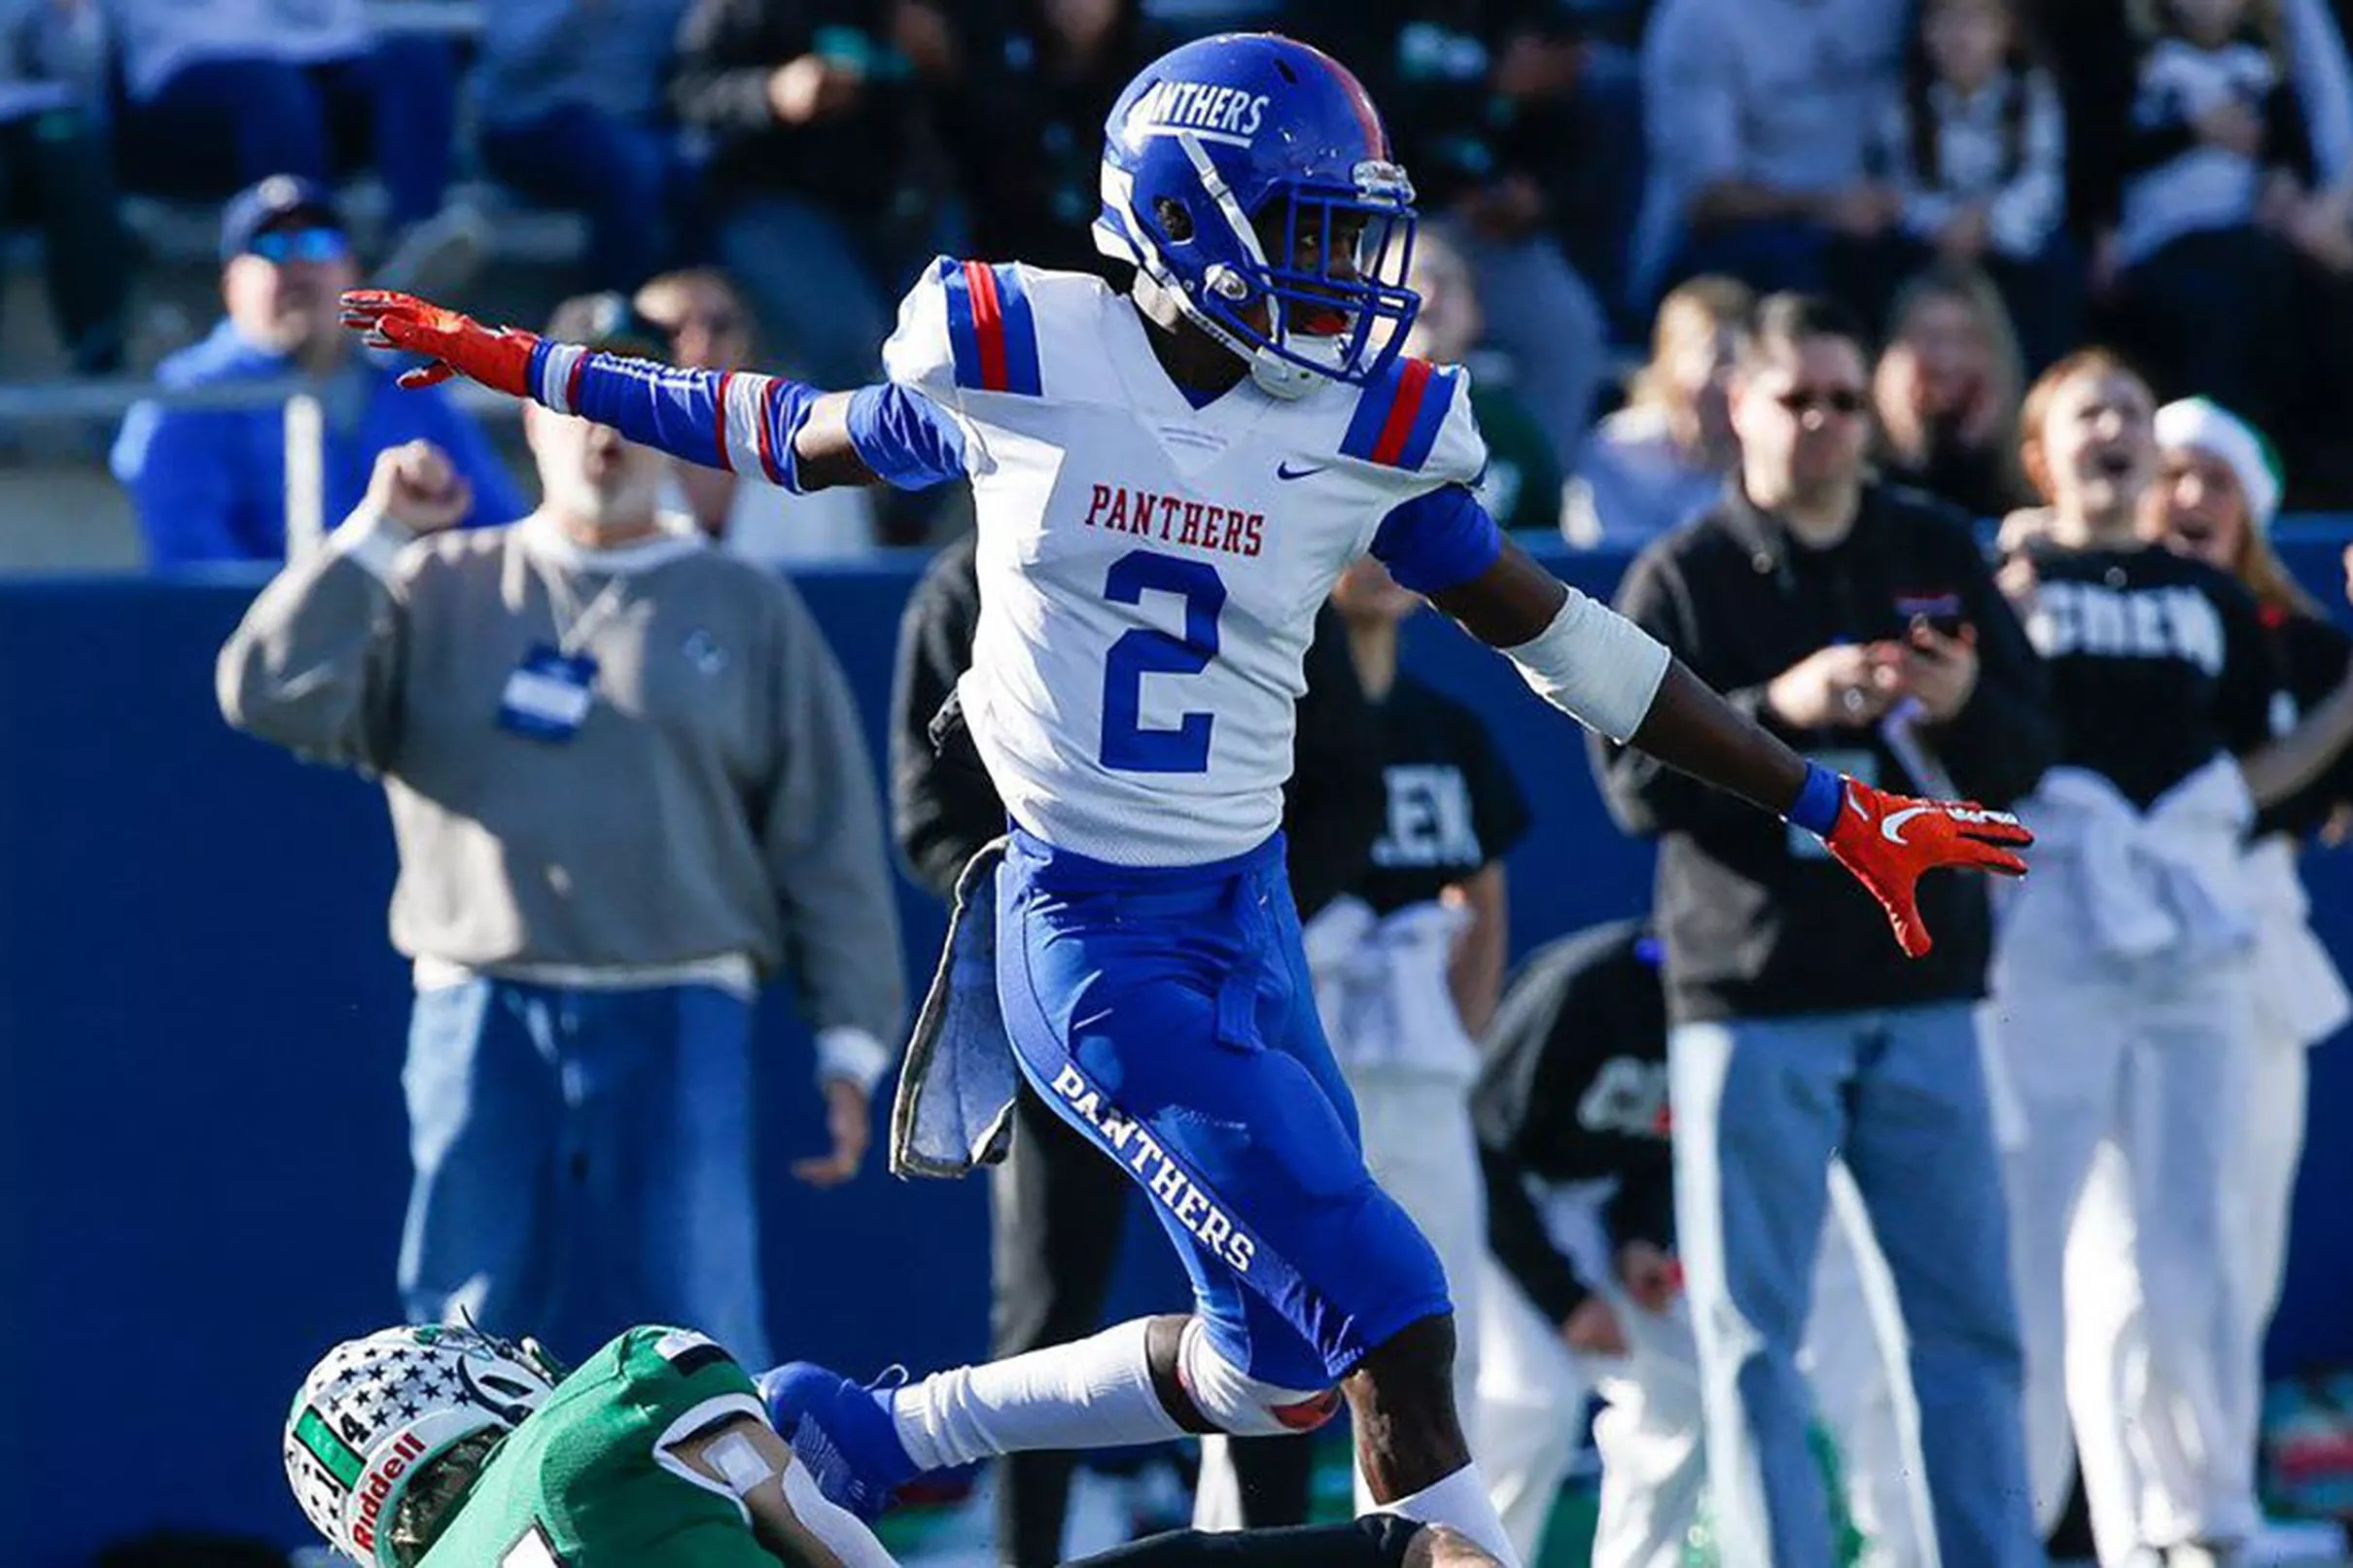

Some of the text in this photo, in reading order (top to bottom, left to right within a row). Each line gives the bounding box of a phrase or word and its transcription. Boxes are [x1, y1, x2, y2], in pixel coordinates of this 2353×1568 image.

[1085, 483, 1264, 557] PANTHERS
[1099, 548, 1227, 773] 2
[1051, 1063, 1255, 1272] PANTHERS
[339, 1411, 371, 1444] 4
[352, 1432, 426, 1553] Riddell
